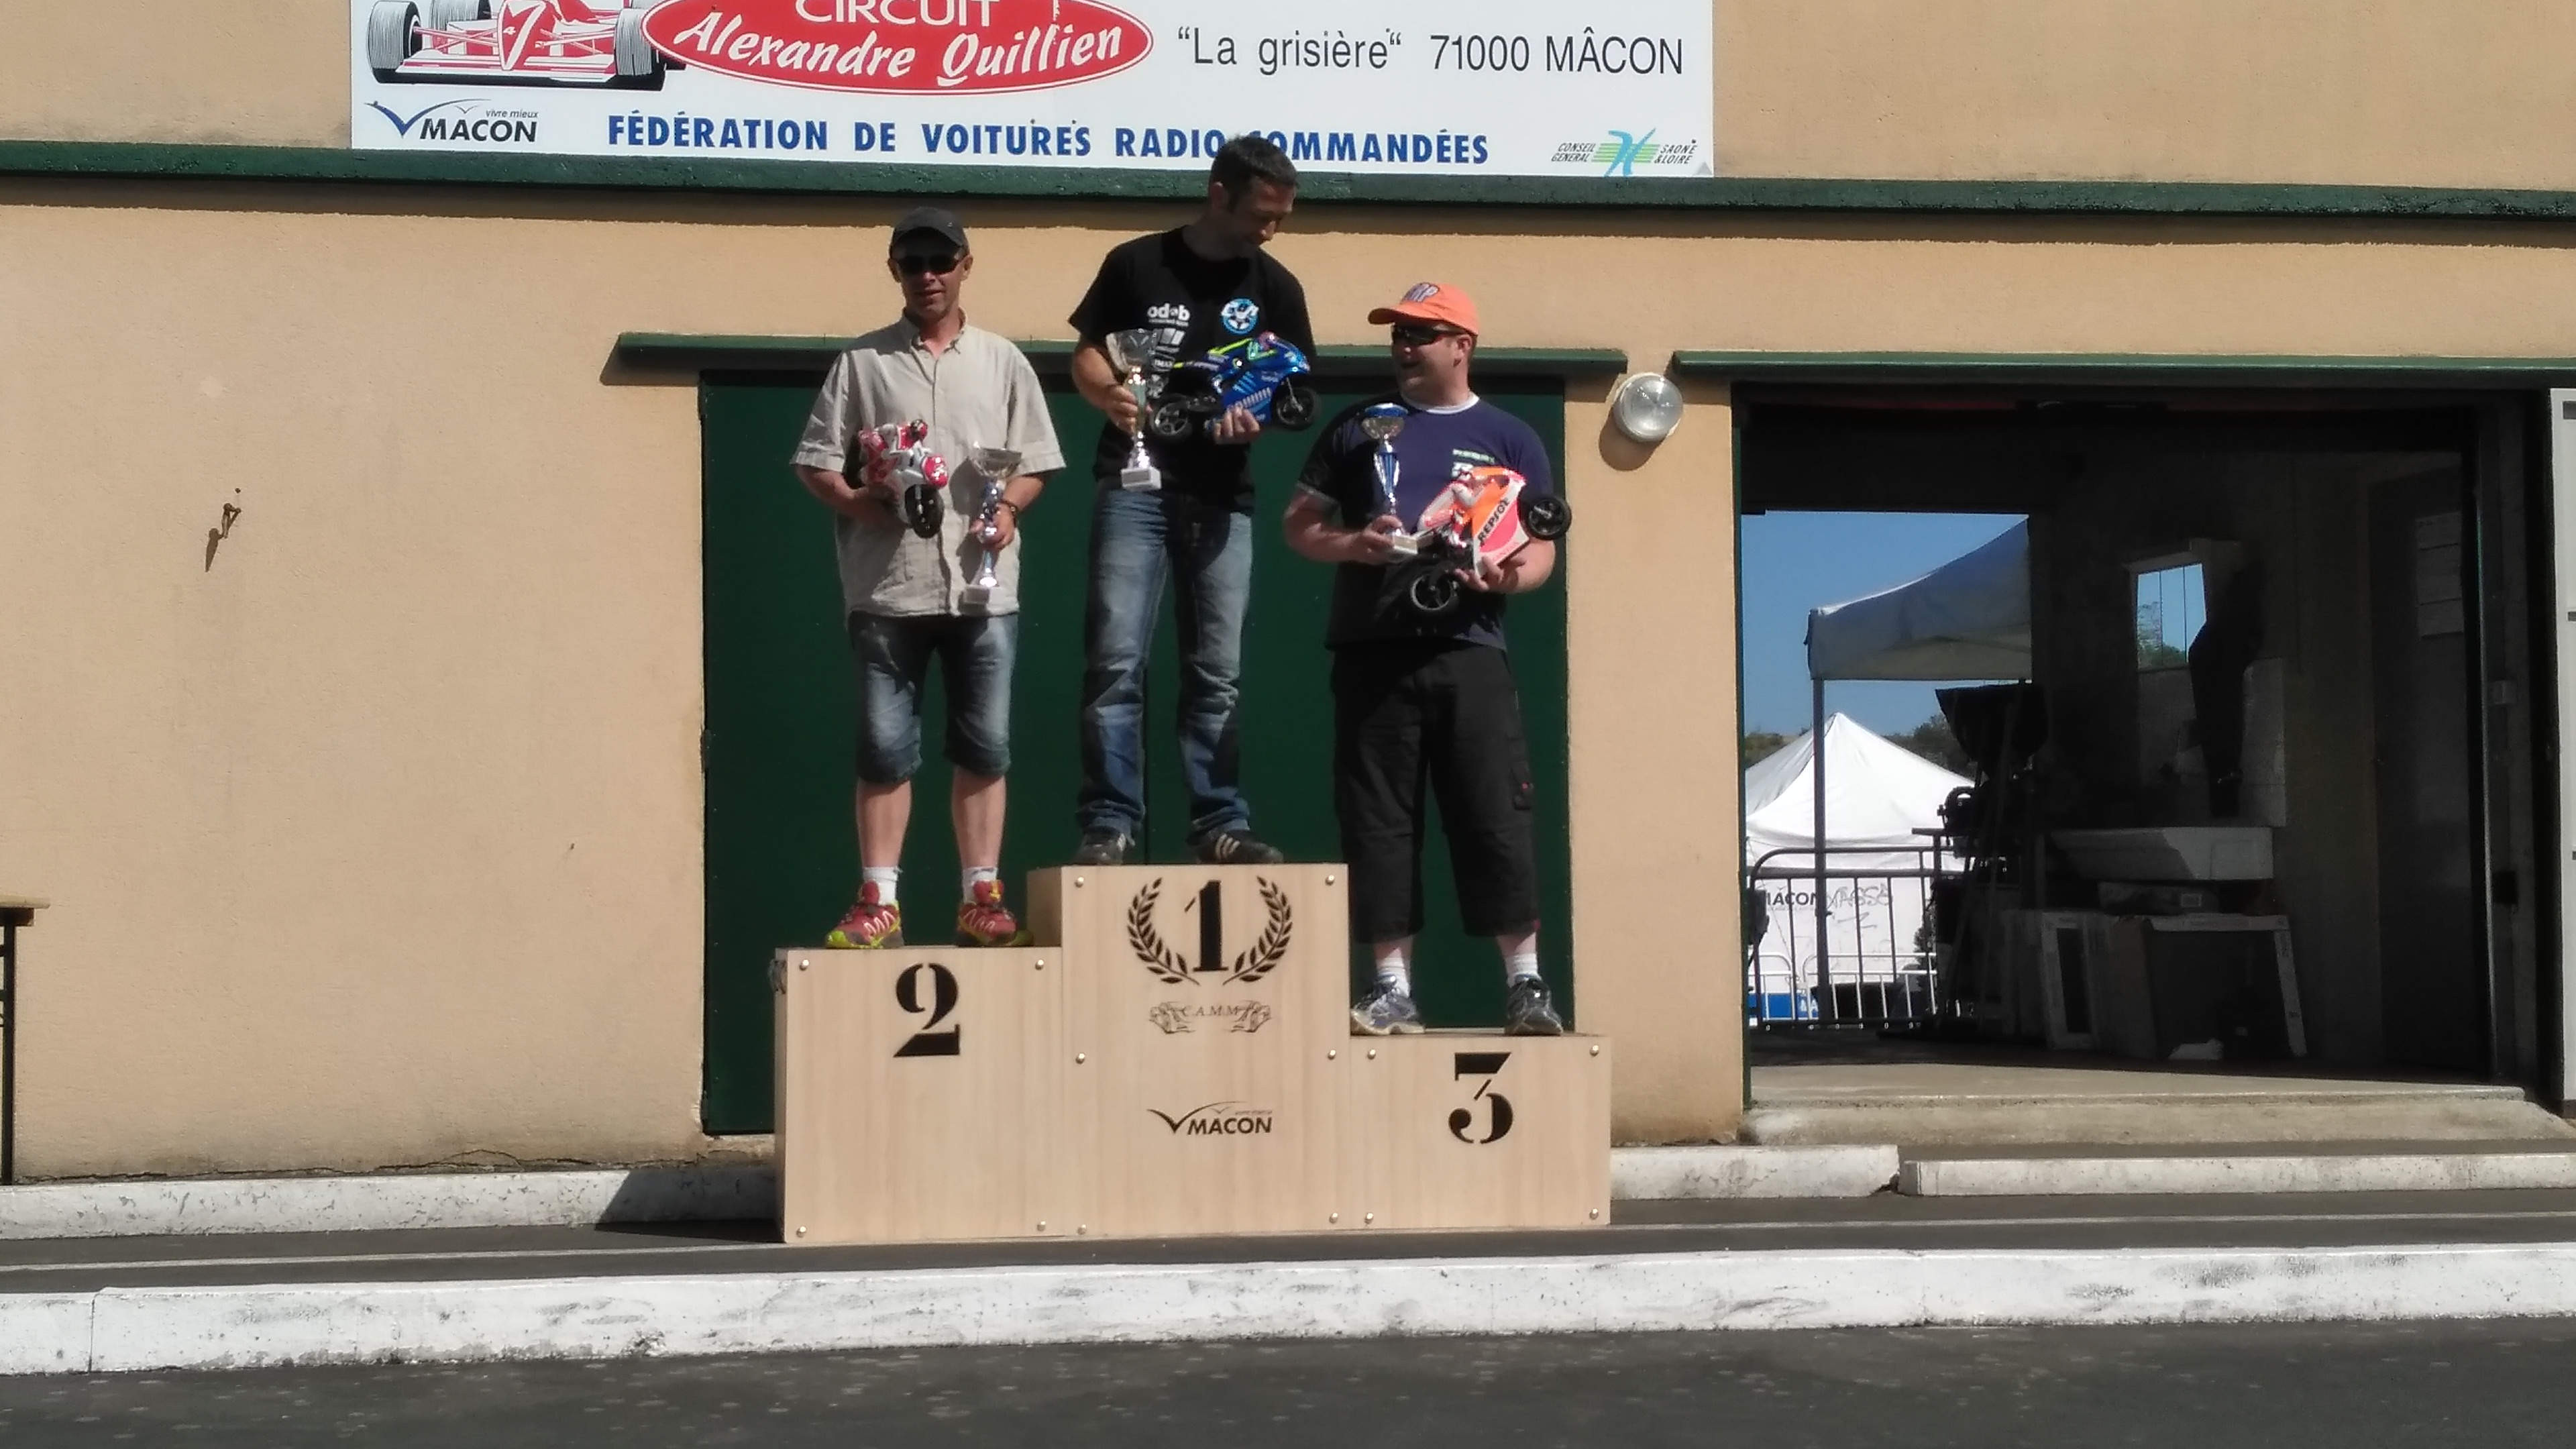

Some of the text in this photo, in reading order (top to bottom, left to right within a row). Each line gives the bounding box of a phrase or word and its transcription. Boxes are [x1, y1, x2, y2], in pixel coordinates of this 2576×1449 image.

[795, 0, 1001, 27] CIRCUIT
[672, 11, 1122, 87] Alexandre Quillien
[1431, 34, 1530, 72] 71000
[1544, 27, 1684, 74] MÂCON
[419, 117, 538, 142] MACON
[485, 108, 539, 119] vivre mieux
[608, 109, 1489, 164] FÉDÉRATION DE VOITURES RADIO OMMANDÉES
[1558, 142, 1597, 152] CONSEIL
[1550, 152, 1591, 162] GENERAL
[1183, 879, 1229, 975] 1
[894, 963, 960, 1058] 2
[1448, 1052, 1513, 1144] 3
[1187, 1117, 1272, 1135] MACON
